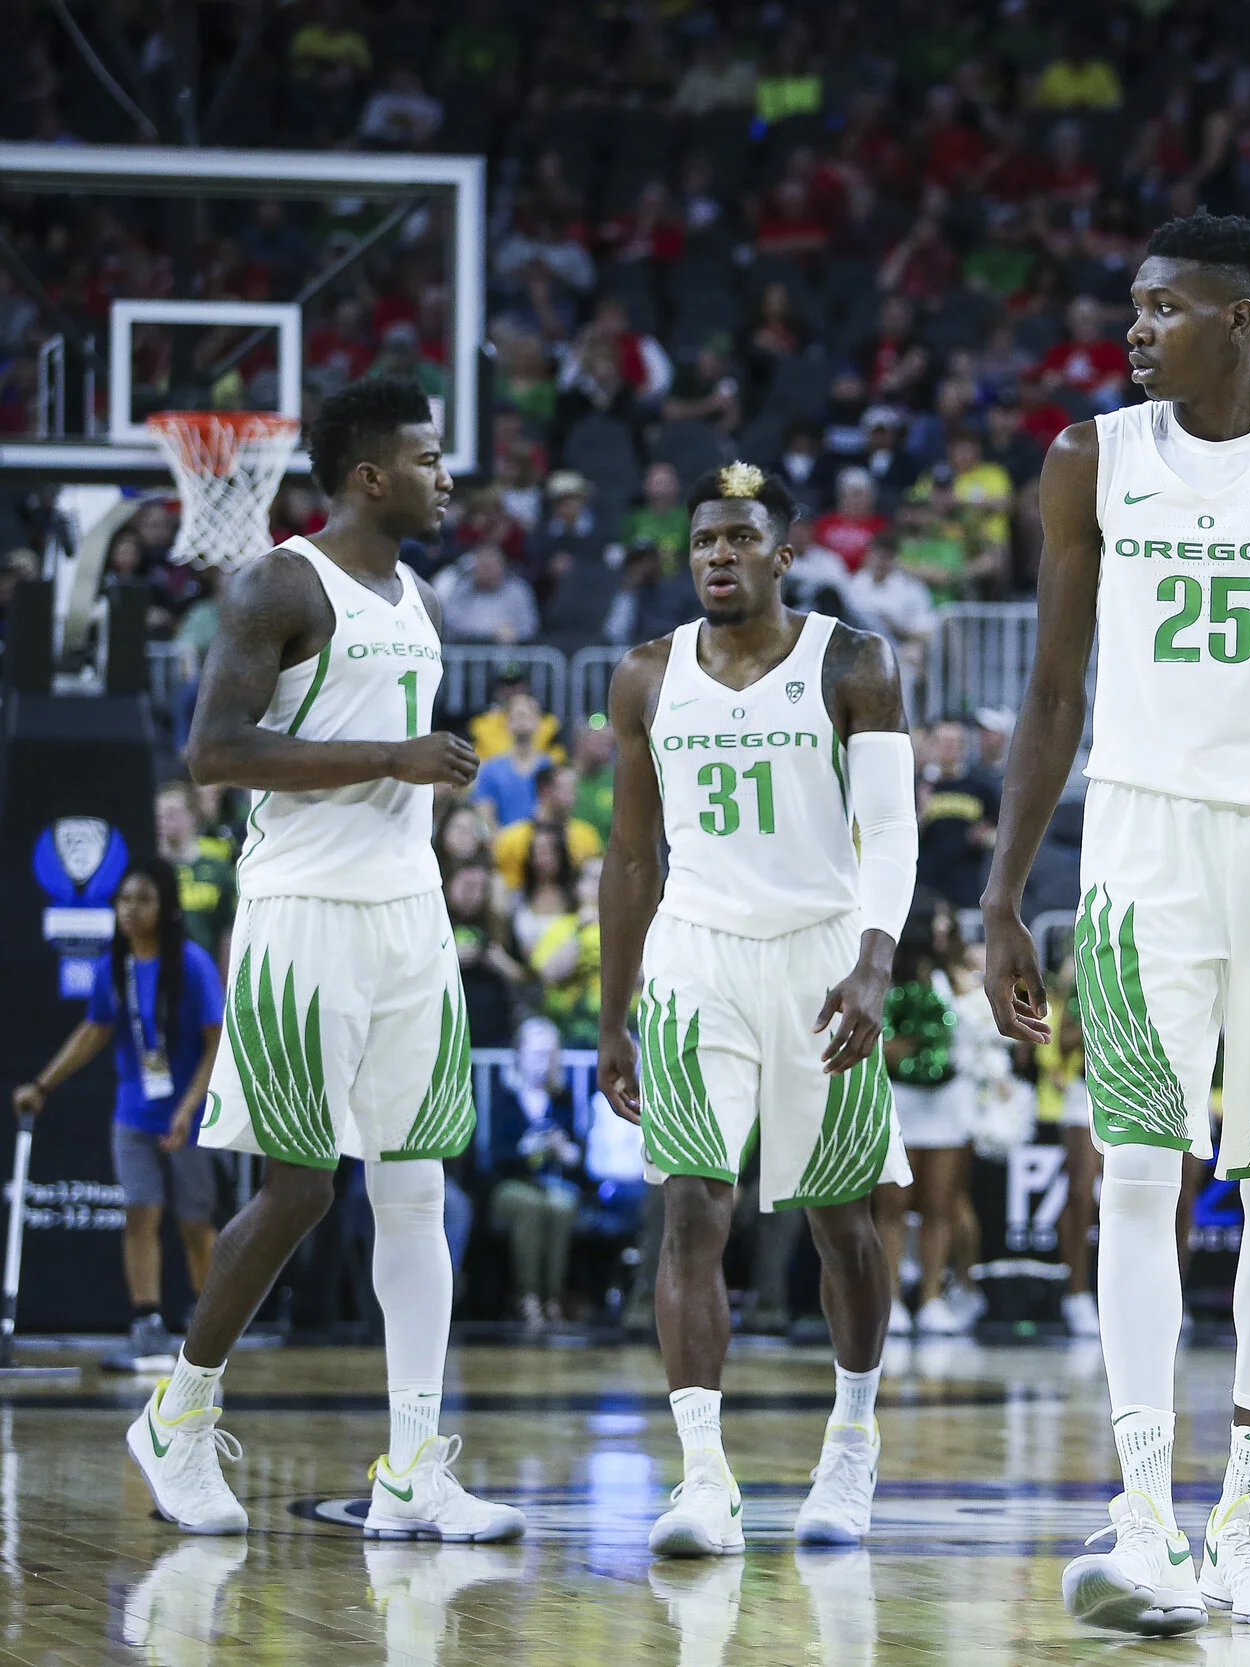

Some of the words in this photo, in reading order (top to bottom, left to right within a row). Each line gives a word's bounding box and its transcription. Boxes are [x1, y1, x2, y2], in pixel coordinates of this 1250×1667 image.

[1198, 515, 1215, 529] O
[398, 670, 418, 738] 1
[732, 707, 745, 720] O
[663, 731, 819, 752] OREGON
[697, 760, 776, 837] 31
